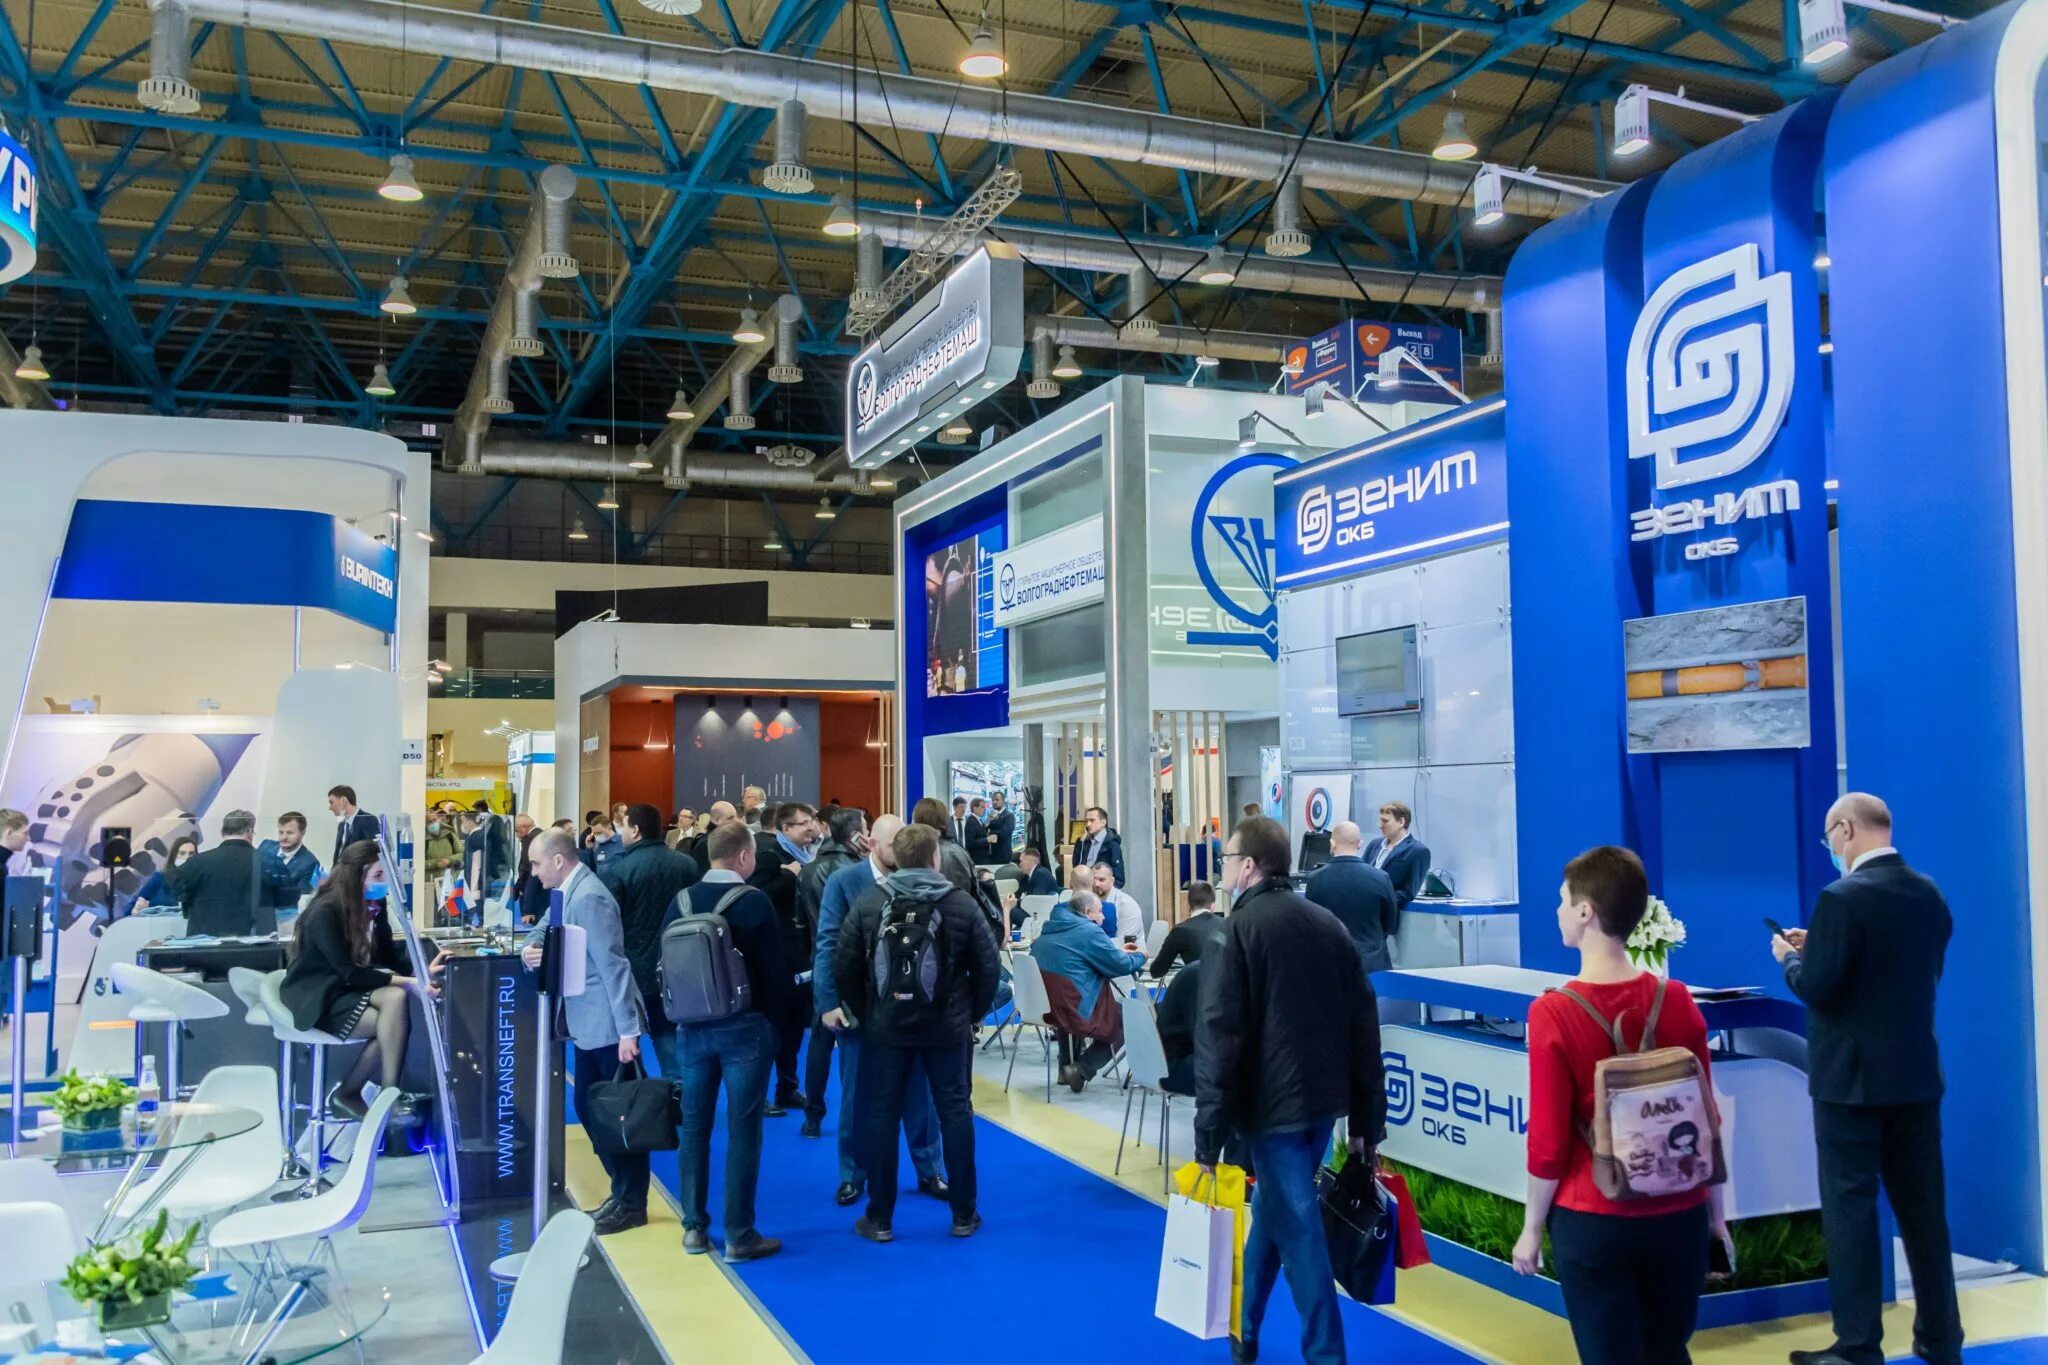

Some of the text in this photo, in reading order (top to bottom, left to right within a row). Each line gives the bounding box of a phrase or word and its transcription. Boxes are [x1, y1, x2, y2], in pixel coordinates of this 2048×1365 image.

[1398, 328, 1423, 340] Выход
[1423, 347, 1430, 356] 8
[874, 320, 977, 416] ВОЛГОГРАДНЕФТЕМАШ
[1336, 521, 1375, 546] ОКБ
[1685, 537, 1739, 561] ОКБ
[345, 556, 393, 600] BURINTEKH
[498, 976, 515, 1178] WWW.TRANSNEFT.RU
[1422, 1117, 1466, 1145] ОКБ
